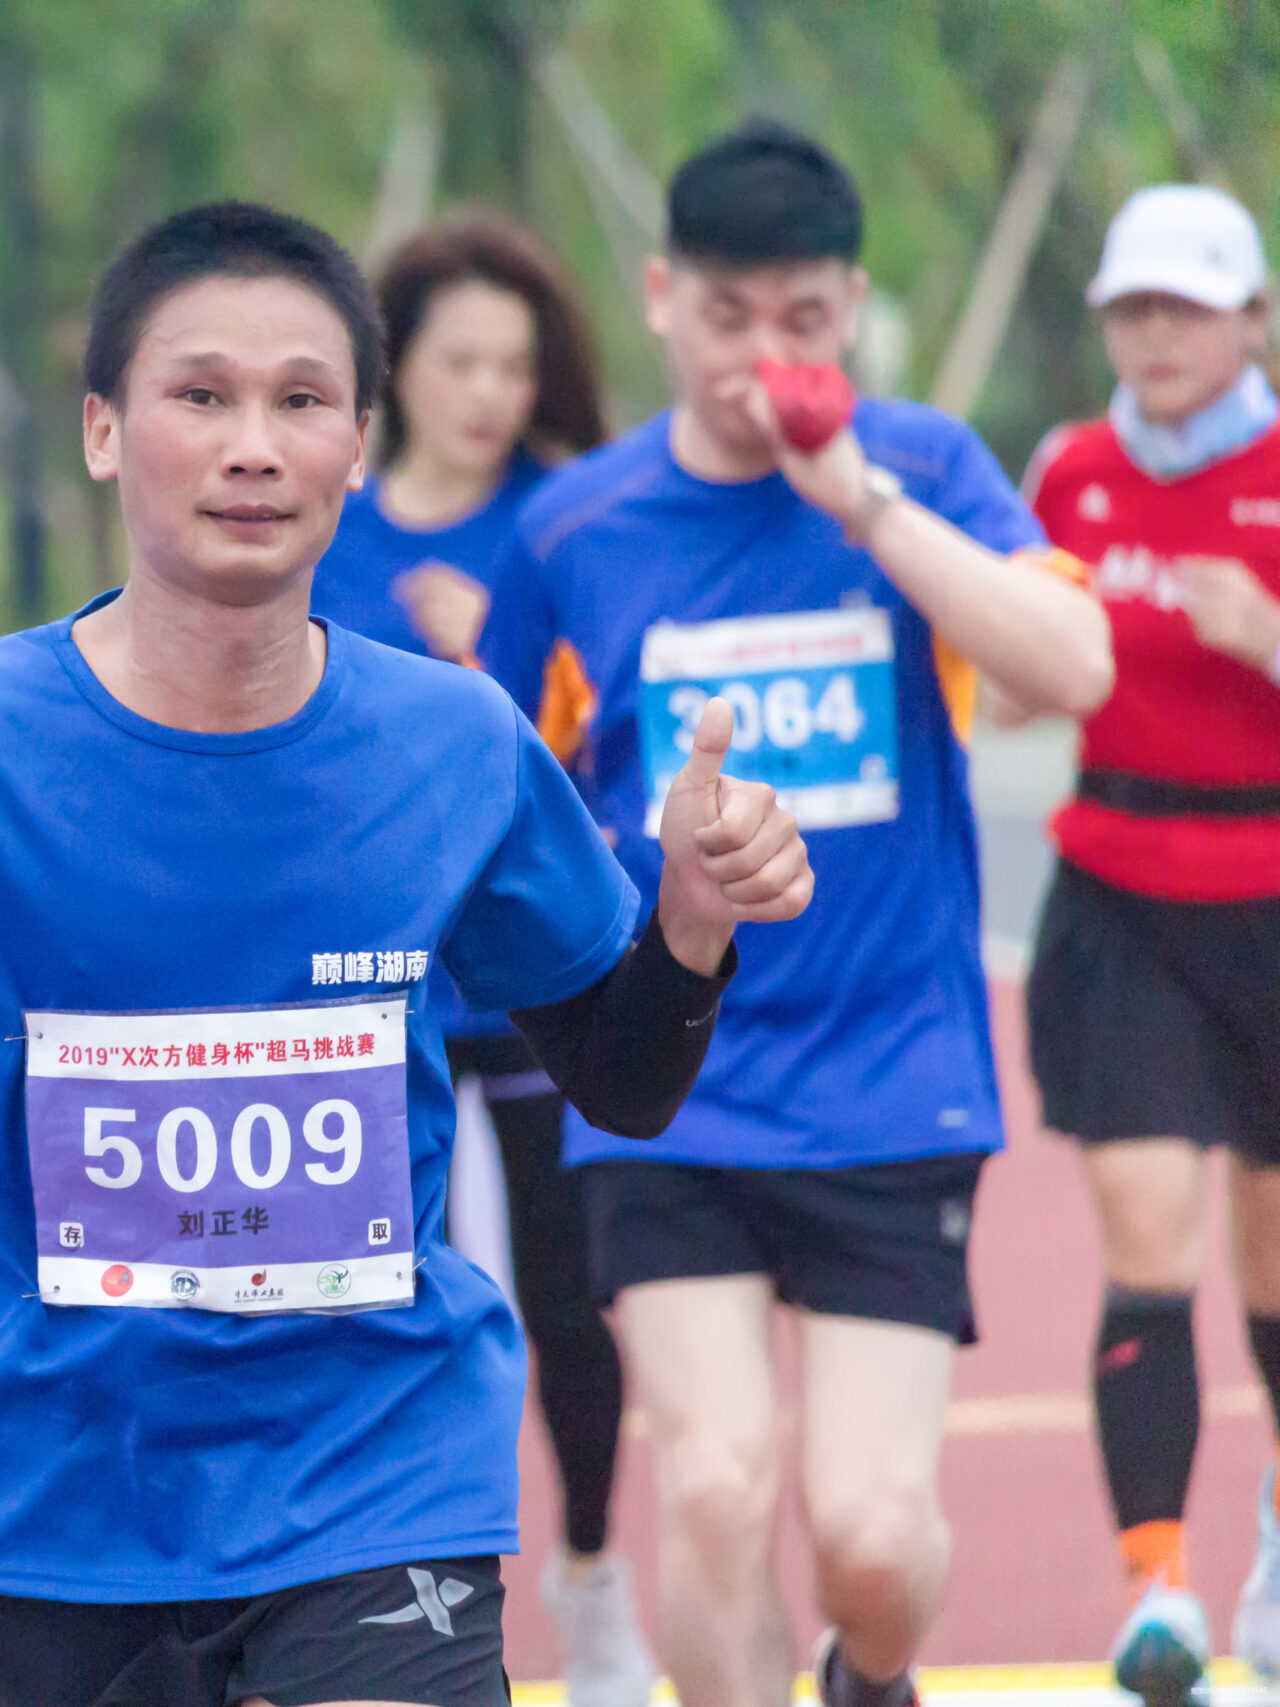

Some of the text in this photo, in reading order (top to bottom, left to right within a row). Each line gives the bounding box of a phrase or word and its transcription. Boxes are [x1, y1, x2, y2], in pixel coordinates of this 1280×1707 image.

[311, 950, 429, 985] 巅峰湖南
[83, 1098, 363, 1193] 5009
[63, 1226, 82, 1244] 存
[177, 1206, 269, 1238] 刘正华
[372, 1222, 389, 1240] 取
